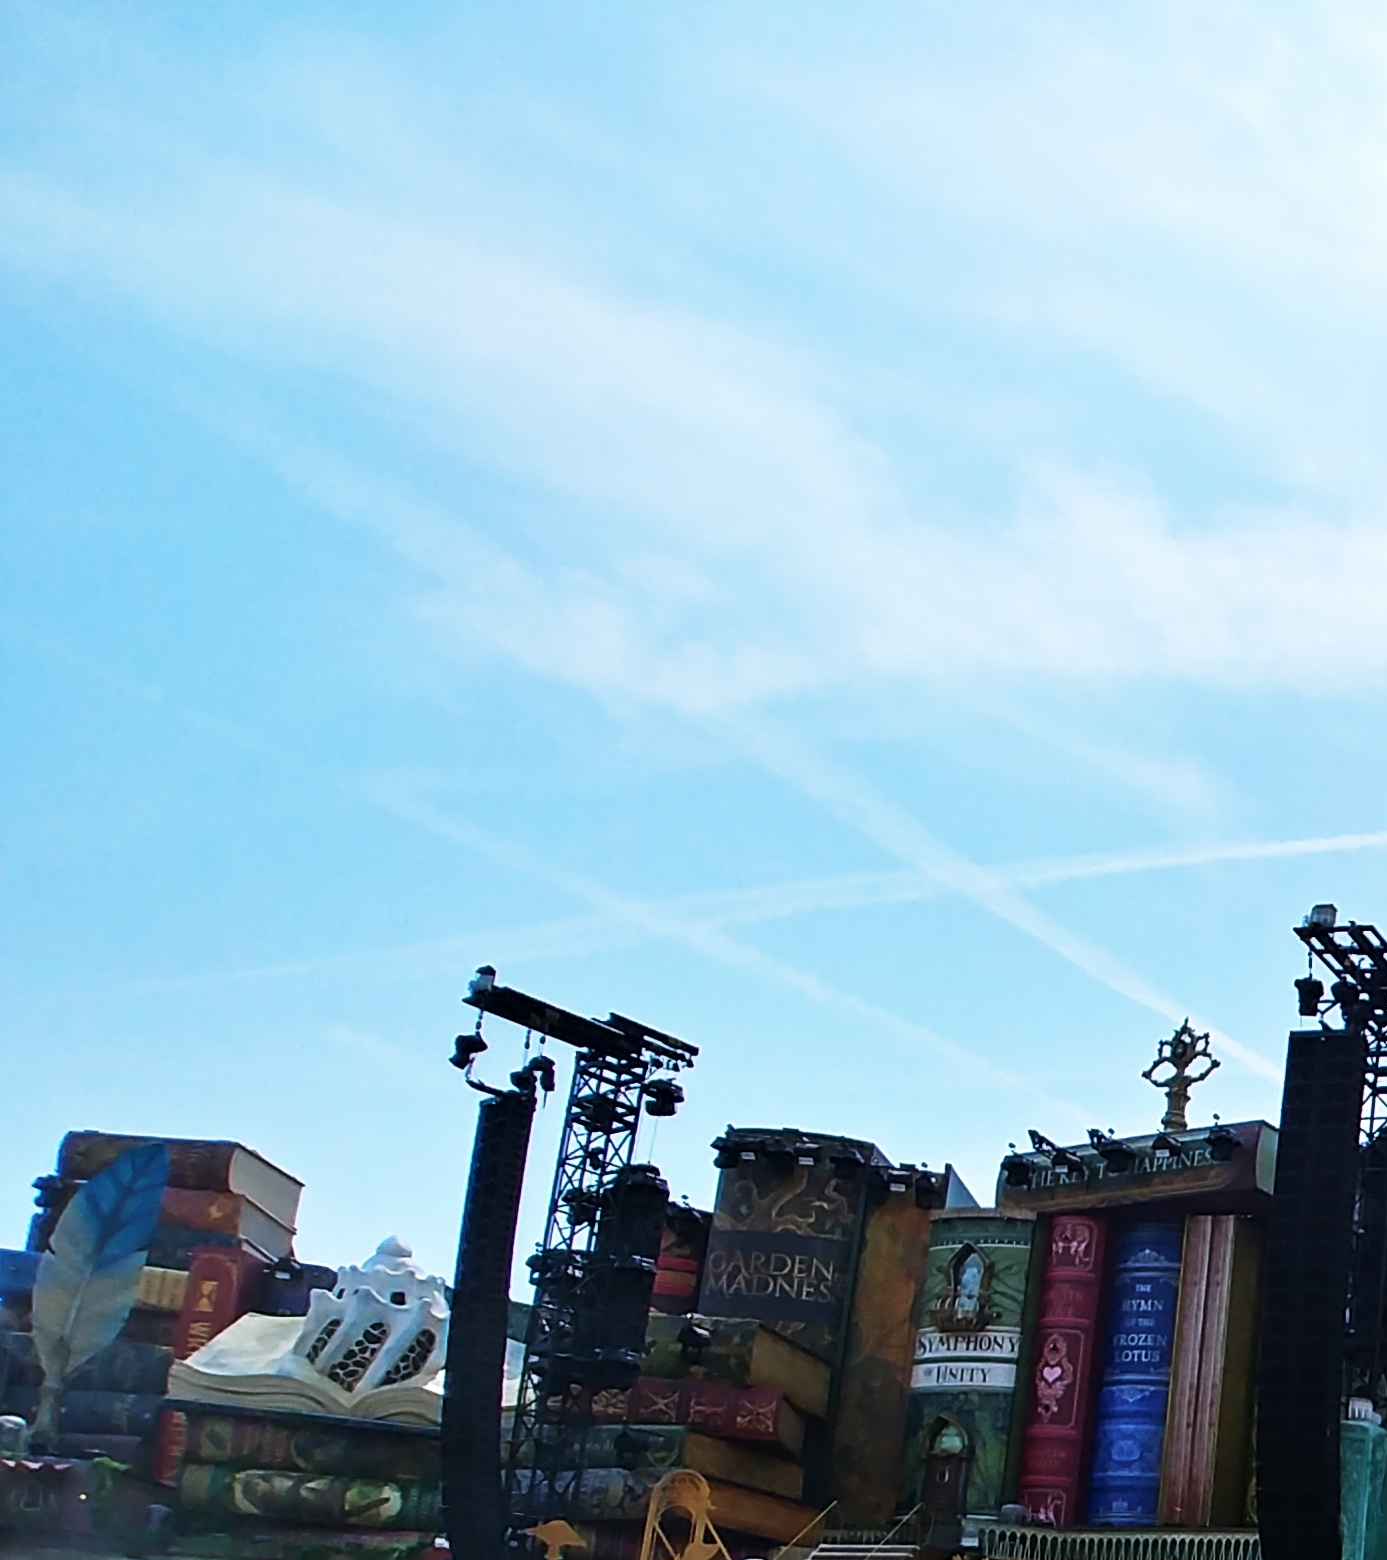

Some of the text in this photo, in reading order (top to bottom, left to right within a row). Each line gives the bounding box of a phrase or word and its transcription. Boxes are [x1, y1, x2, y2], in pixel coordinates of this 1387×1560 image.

[1132, 1147, 1220, 1175] HAPPINES
[708, 1250, 836, 1281] GARDEN
[917, 1333, 1018, 1356] SYMPHONY
[1112, 1333, 1169, 1347] FROZEN
[1113, 1349, 1162, 1362] LOTUS
[936, 1364, 992, 1385] UNITY
